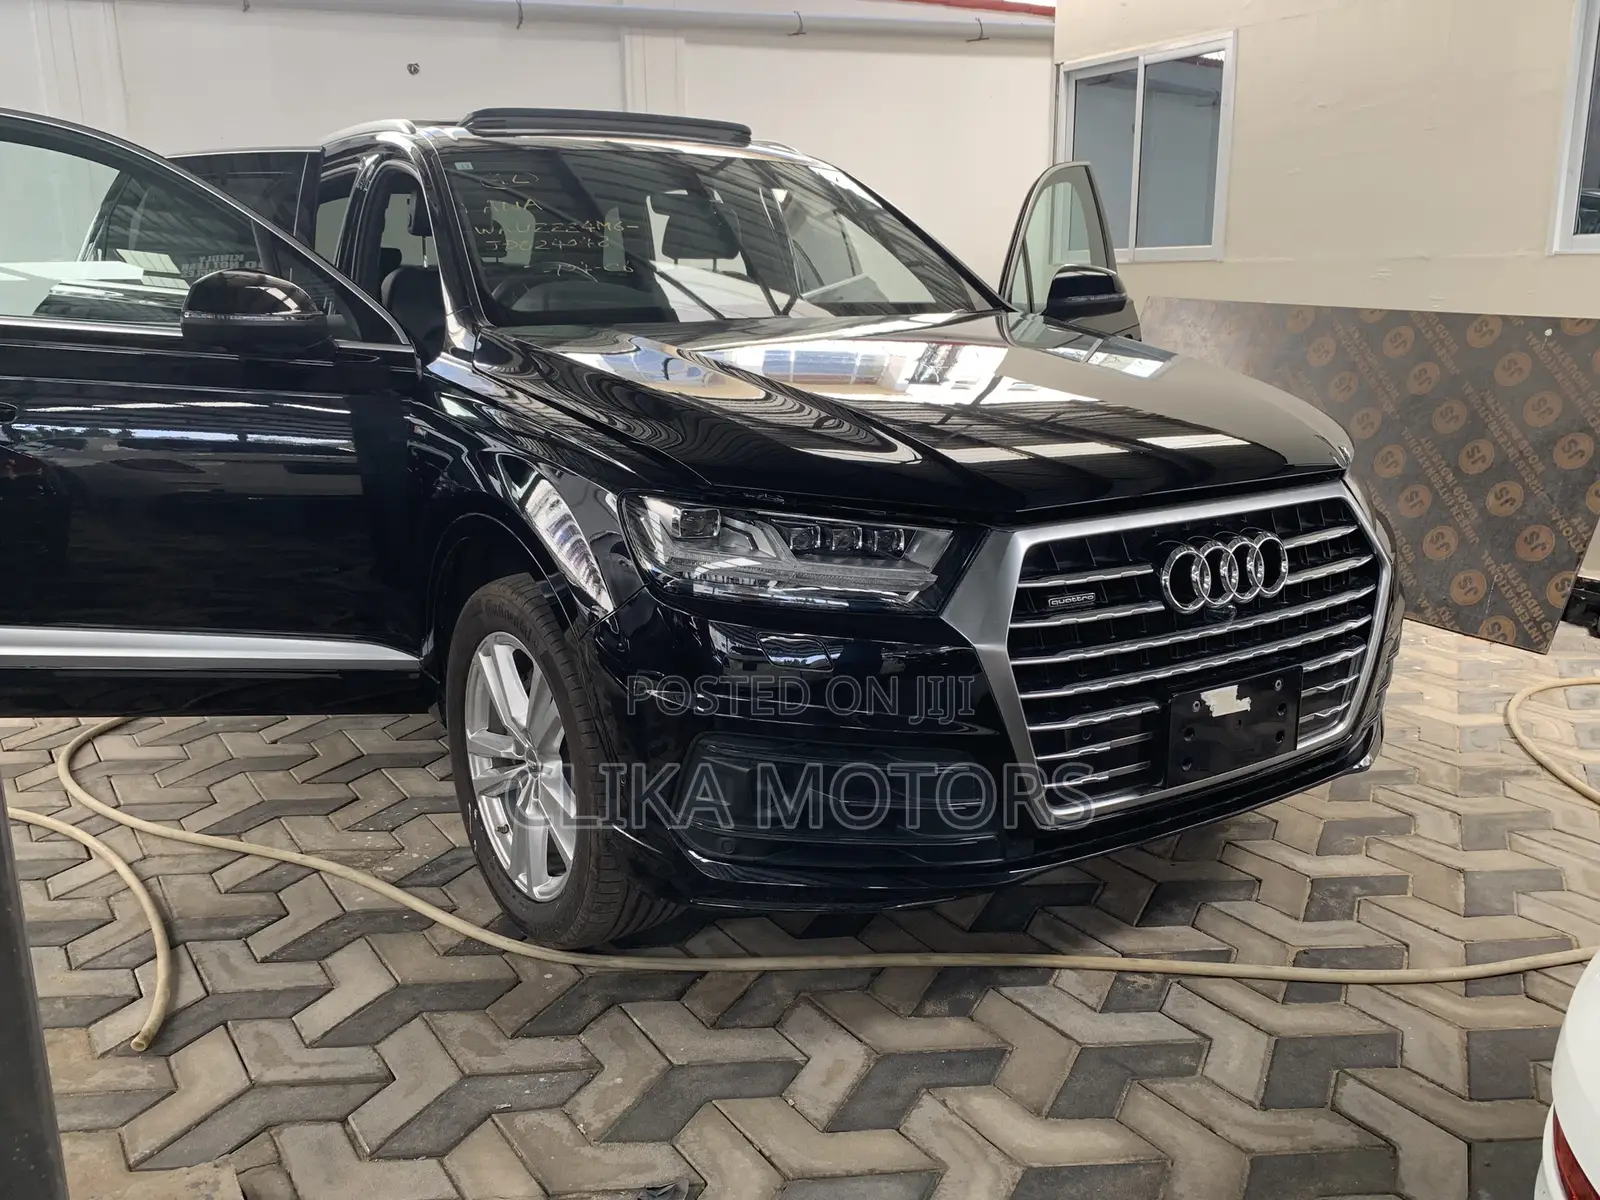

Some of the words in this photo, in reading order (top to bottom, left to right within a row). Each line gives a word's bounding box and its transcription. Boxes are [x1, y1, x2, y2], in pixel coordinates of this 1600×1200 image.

[1051, 595, 1094, 607] quattro
[1481, 549, 1543, 642] INTERNATIONAL
[1501, 563, 1546, 621] INDUSTRY
